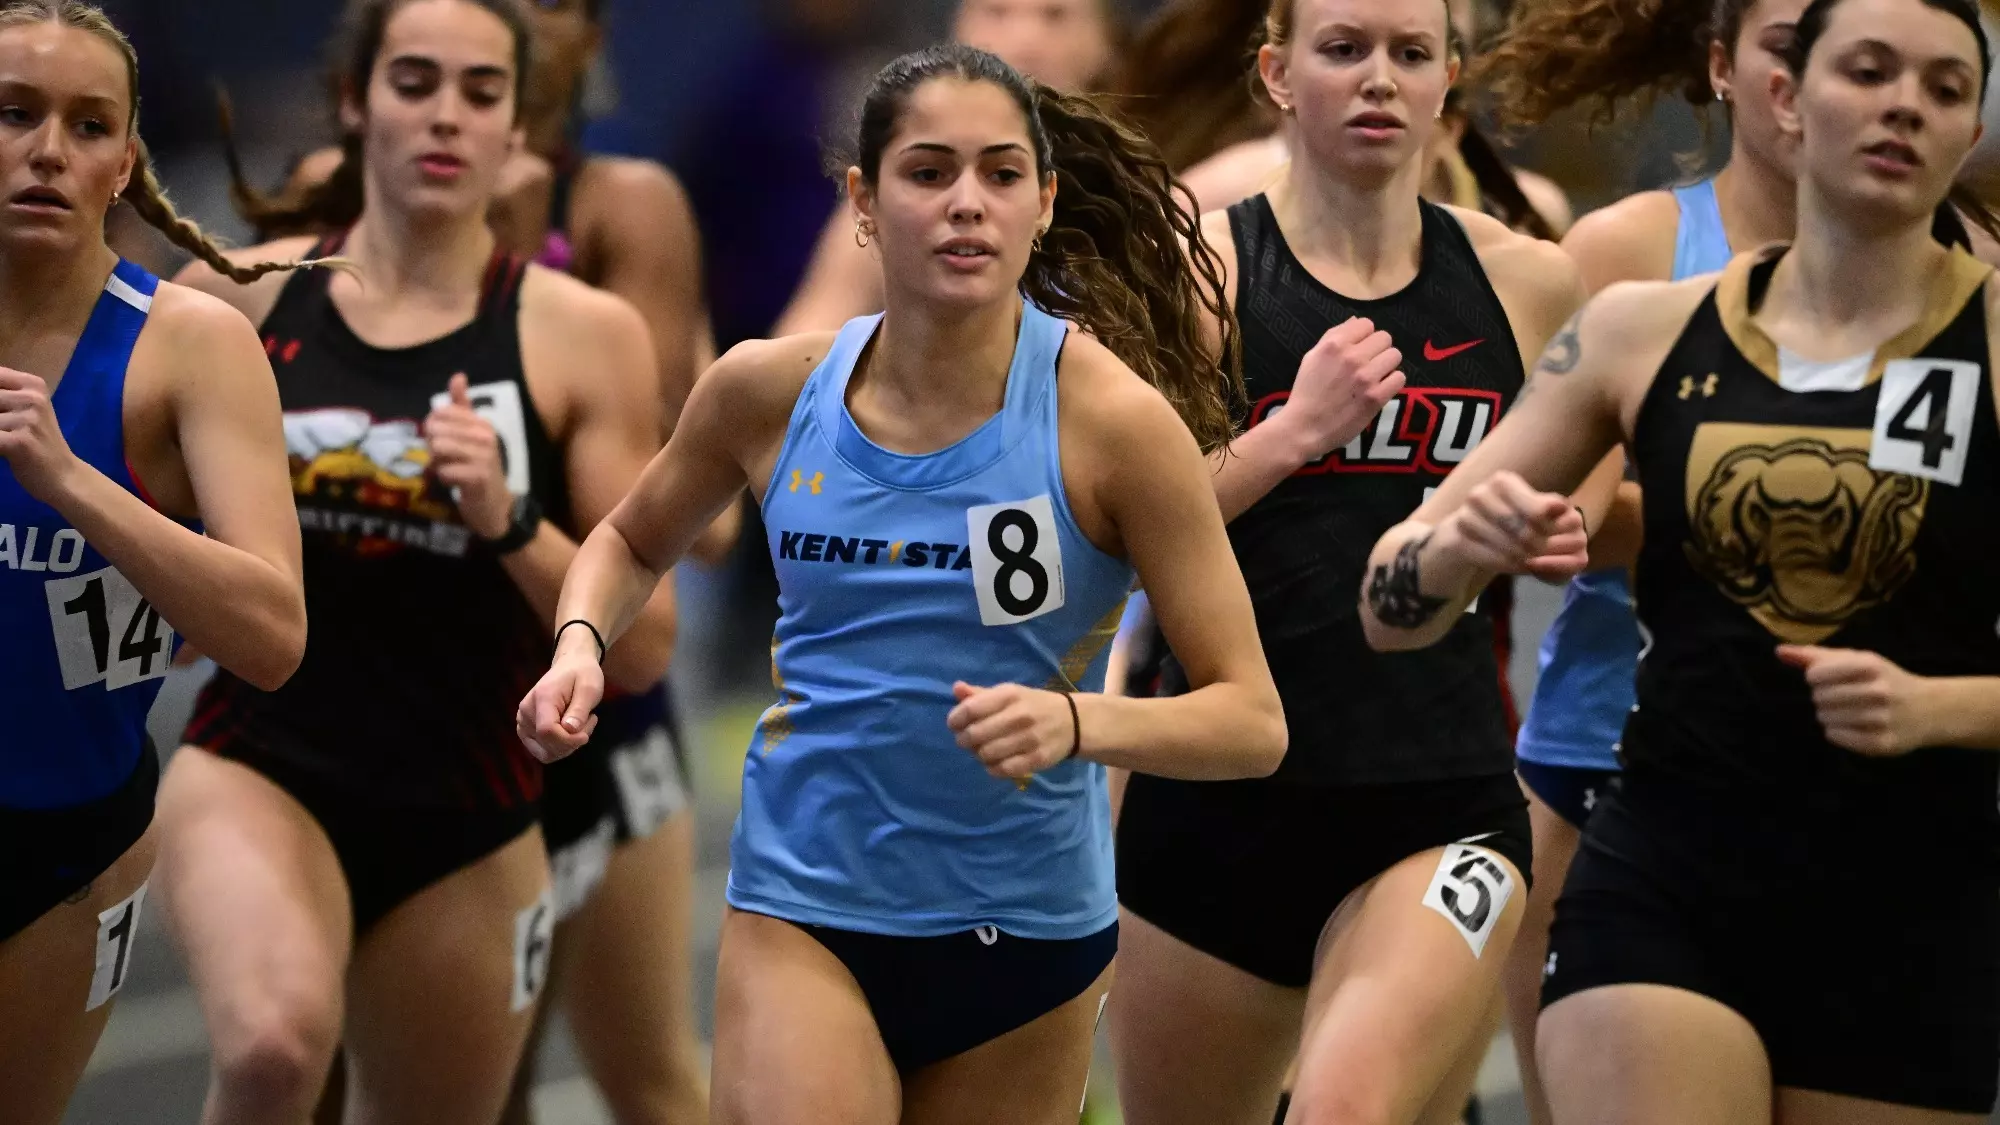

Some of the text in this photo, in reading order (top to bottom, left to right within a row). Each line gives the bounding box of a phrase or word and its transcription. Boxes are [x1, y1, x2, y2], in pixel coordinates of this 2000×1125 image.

[1886, 368, 1954, 469] 4
[779, 530, 889, 565] KENT
[987, 508, 1049, 616] 8
[64, 576, 162, 677] 14
[1440, 849, 1505, 933] 5
[108, 901, 134, 992] 1
